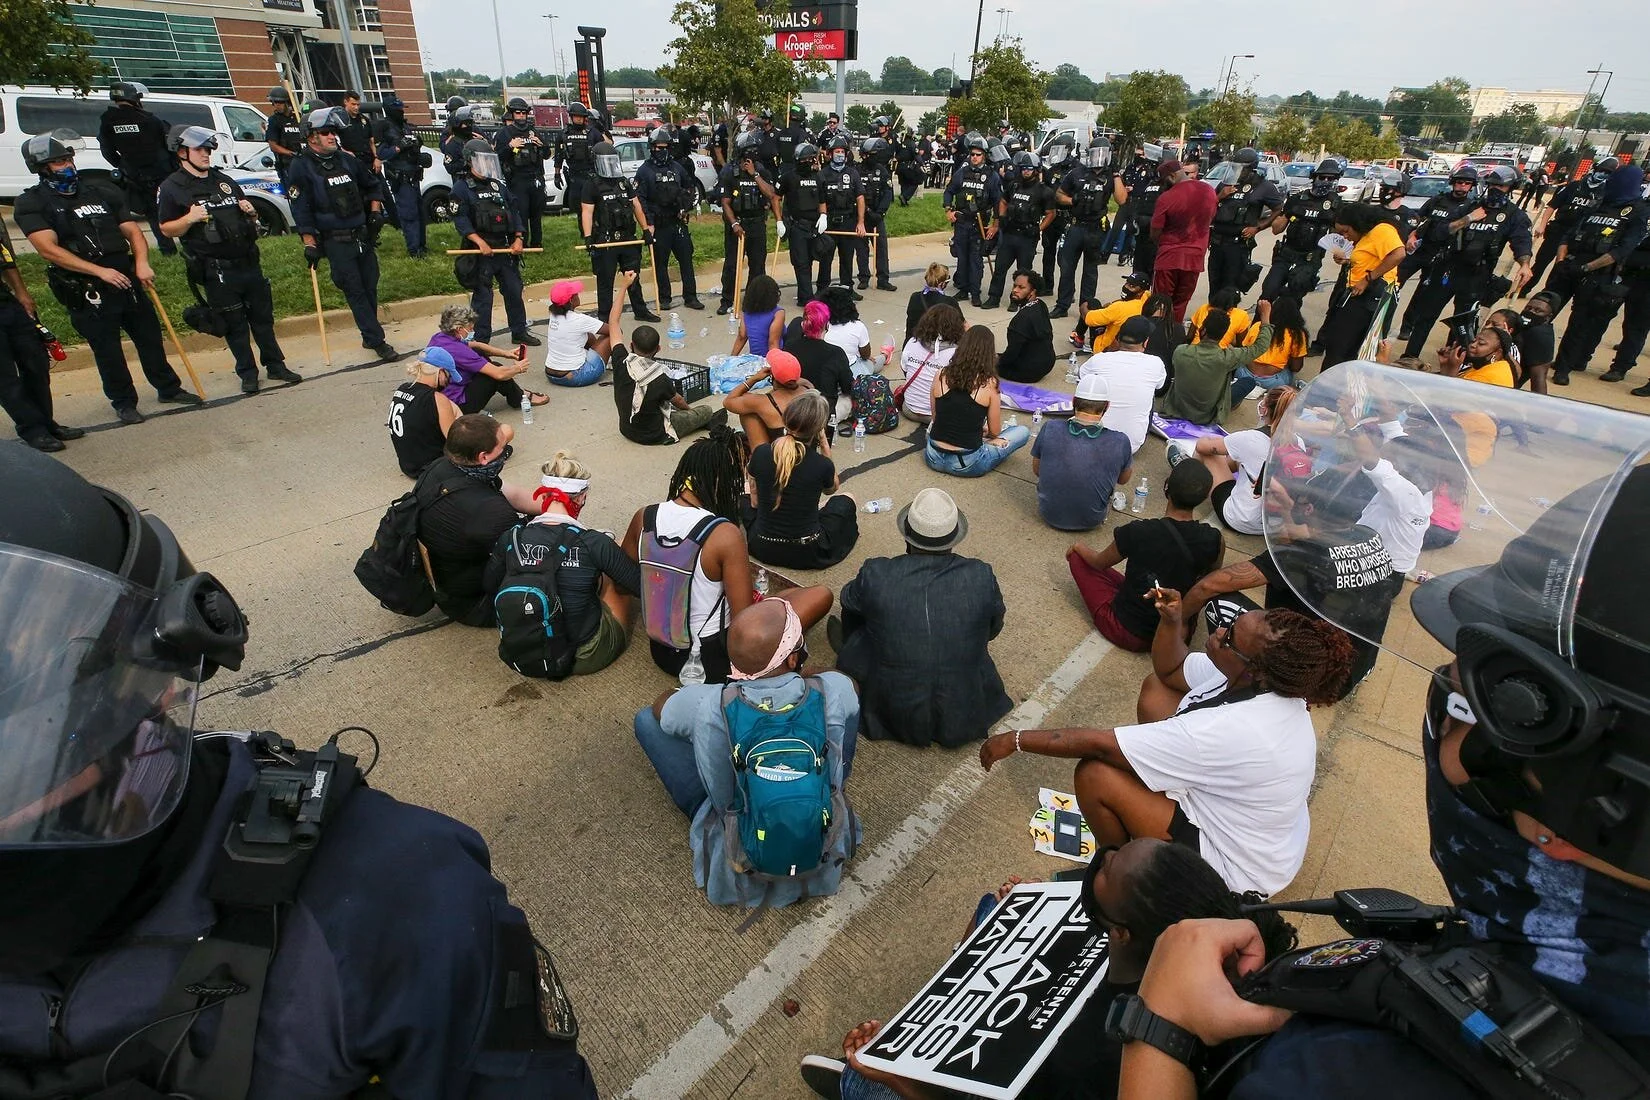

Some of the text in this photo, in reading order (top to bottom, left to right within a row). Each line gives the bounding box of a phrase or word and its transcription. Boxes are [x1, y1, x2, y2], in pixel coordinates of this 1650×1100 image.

[784, 34, 813, 59] Kroger
[114, 125, 138, 133] POLICE
[697, 160, 708, 168] 911
[962, 181, 985, 190] POLICE
[1013, 193, 1030, 202] POLICE
[1586, 215, 1620, 227] POLICE
[1334, 559, 1359, 574] WHO
[1336, 570, 1378, 589] BREONNA
[877, 895, 1030, 1054] MATTER
[911, 895, 1072, 1061] LIVES
